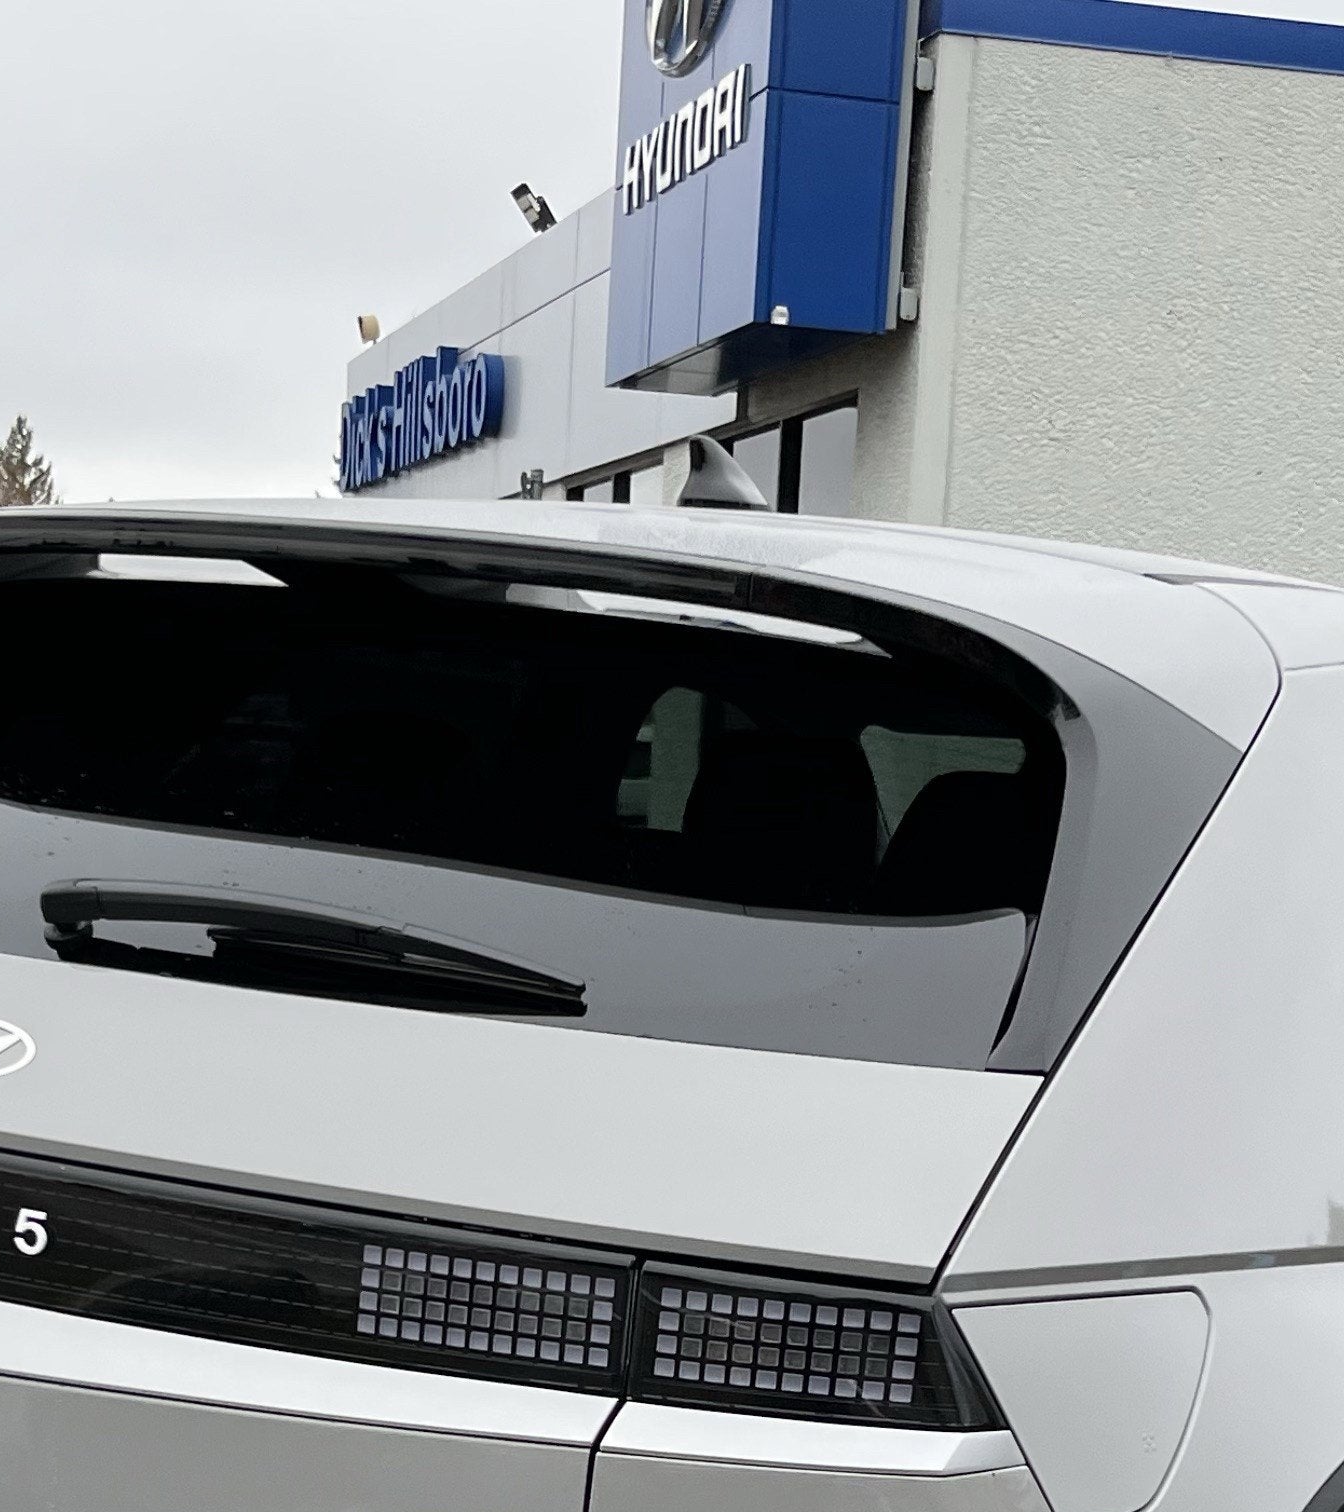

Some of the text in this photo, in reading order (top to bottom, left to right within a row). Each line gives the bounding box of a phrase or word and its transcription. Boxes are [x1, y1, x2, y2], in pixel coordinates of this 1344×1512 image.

[623, 64, 747, 216] HYUNDAI
[339, 346, 489, 492] Dick's Hillsboro
[14, 1208, 49, 1256] 5
